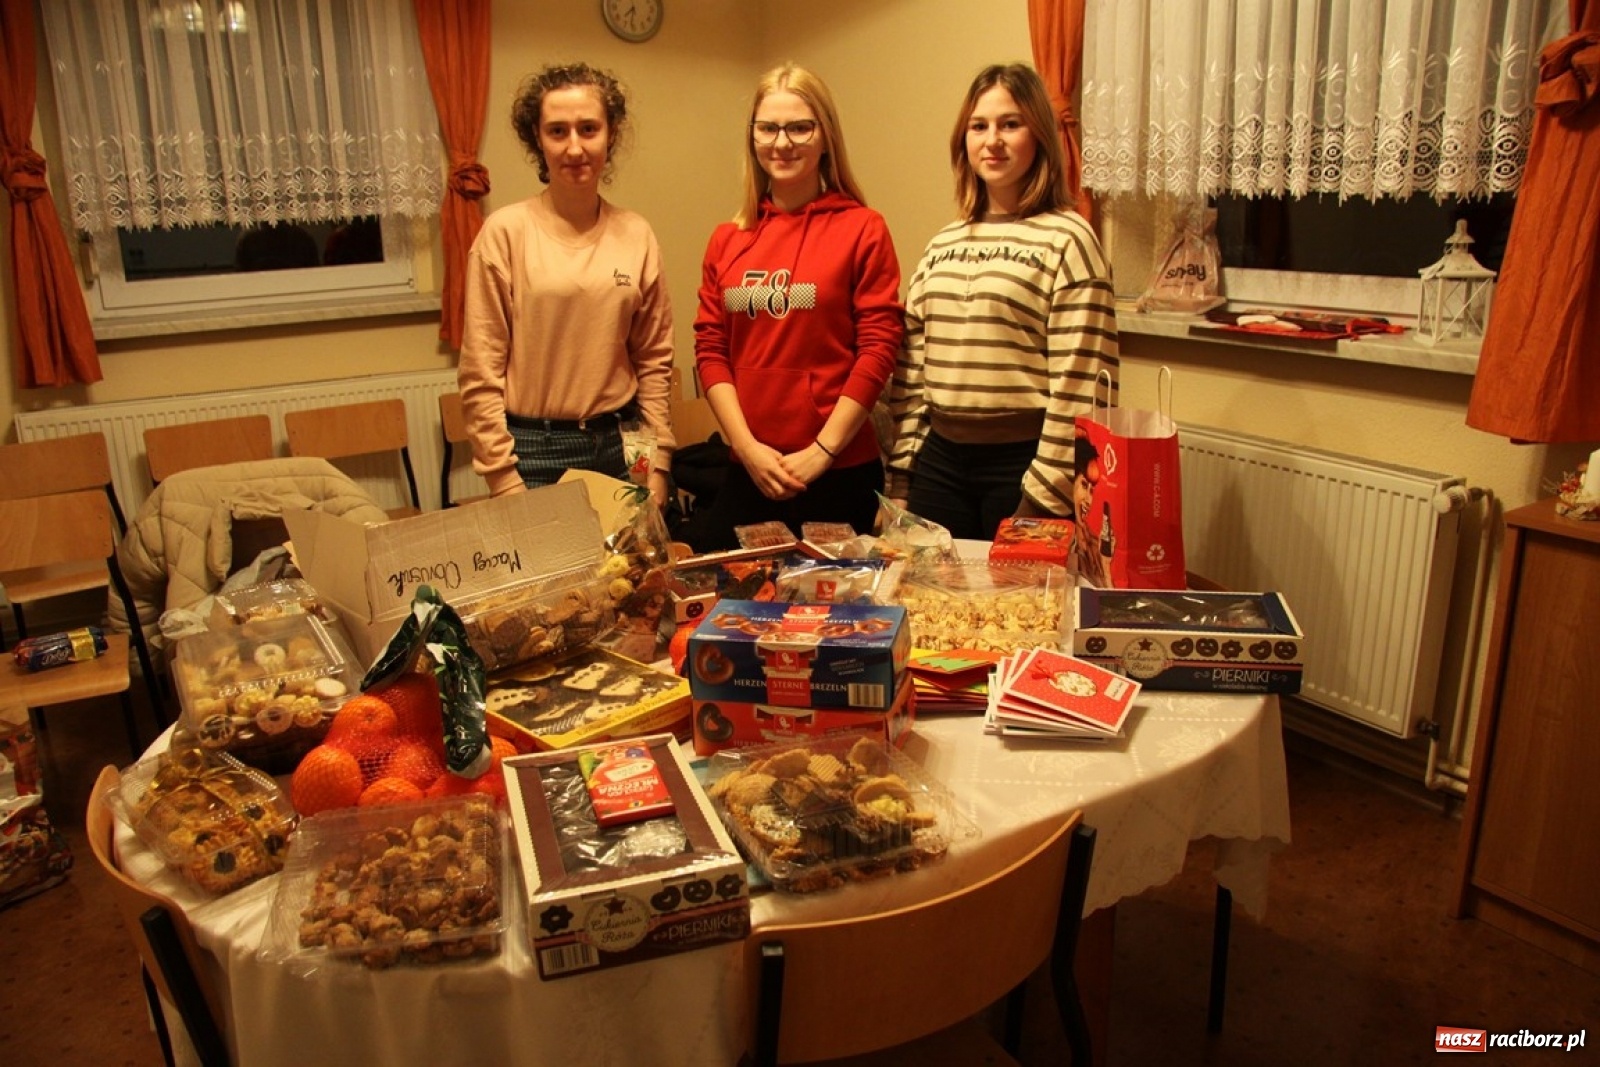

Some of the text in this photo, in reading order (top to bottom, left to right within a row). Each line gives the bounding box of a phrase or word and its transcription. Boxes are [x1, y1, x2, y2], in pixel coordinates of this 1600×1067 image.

[741, 269, 791, 320] 78
[472, 549, 522, 575] Maciej
[733, 678, 847, 692] HERZEN STERNE BREZELN
[1212, 668, 1270, 683] PIERNIKI
[668, 914, 732, 940] PIERNIKI
